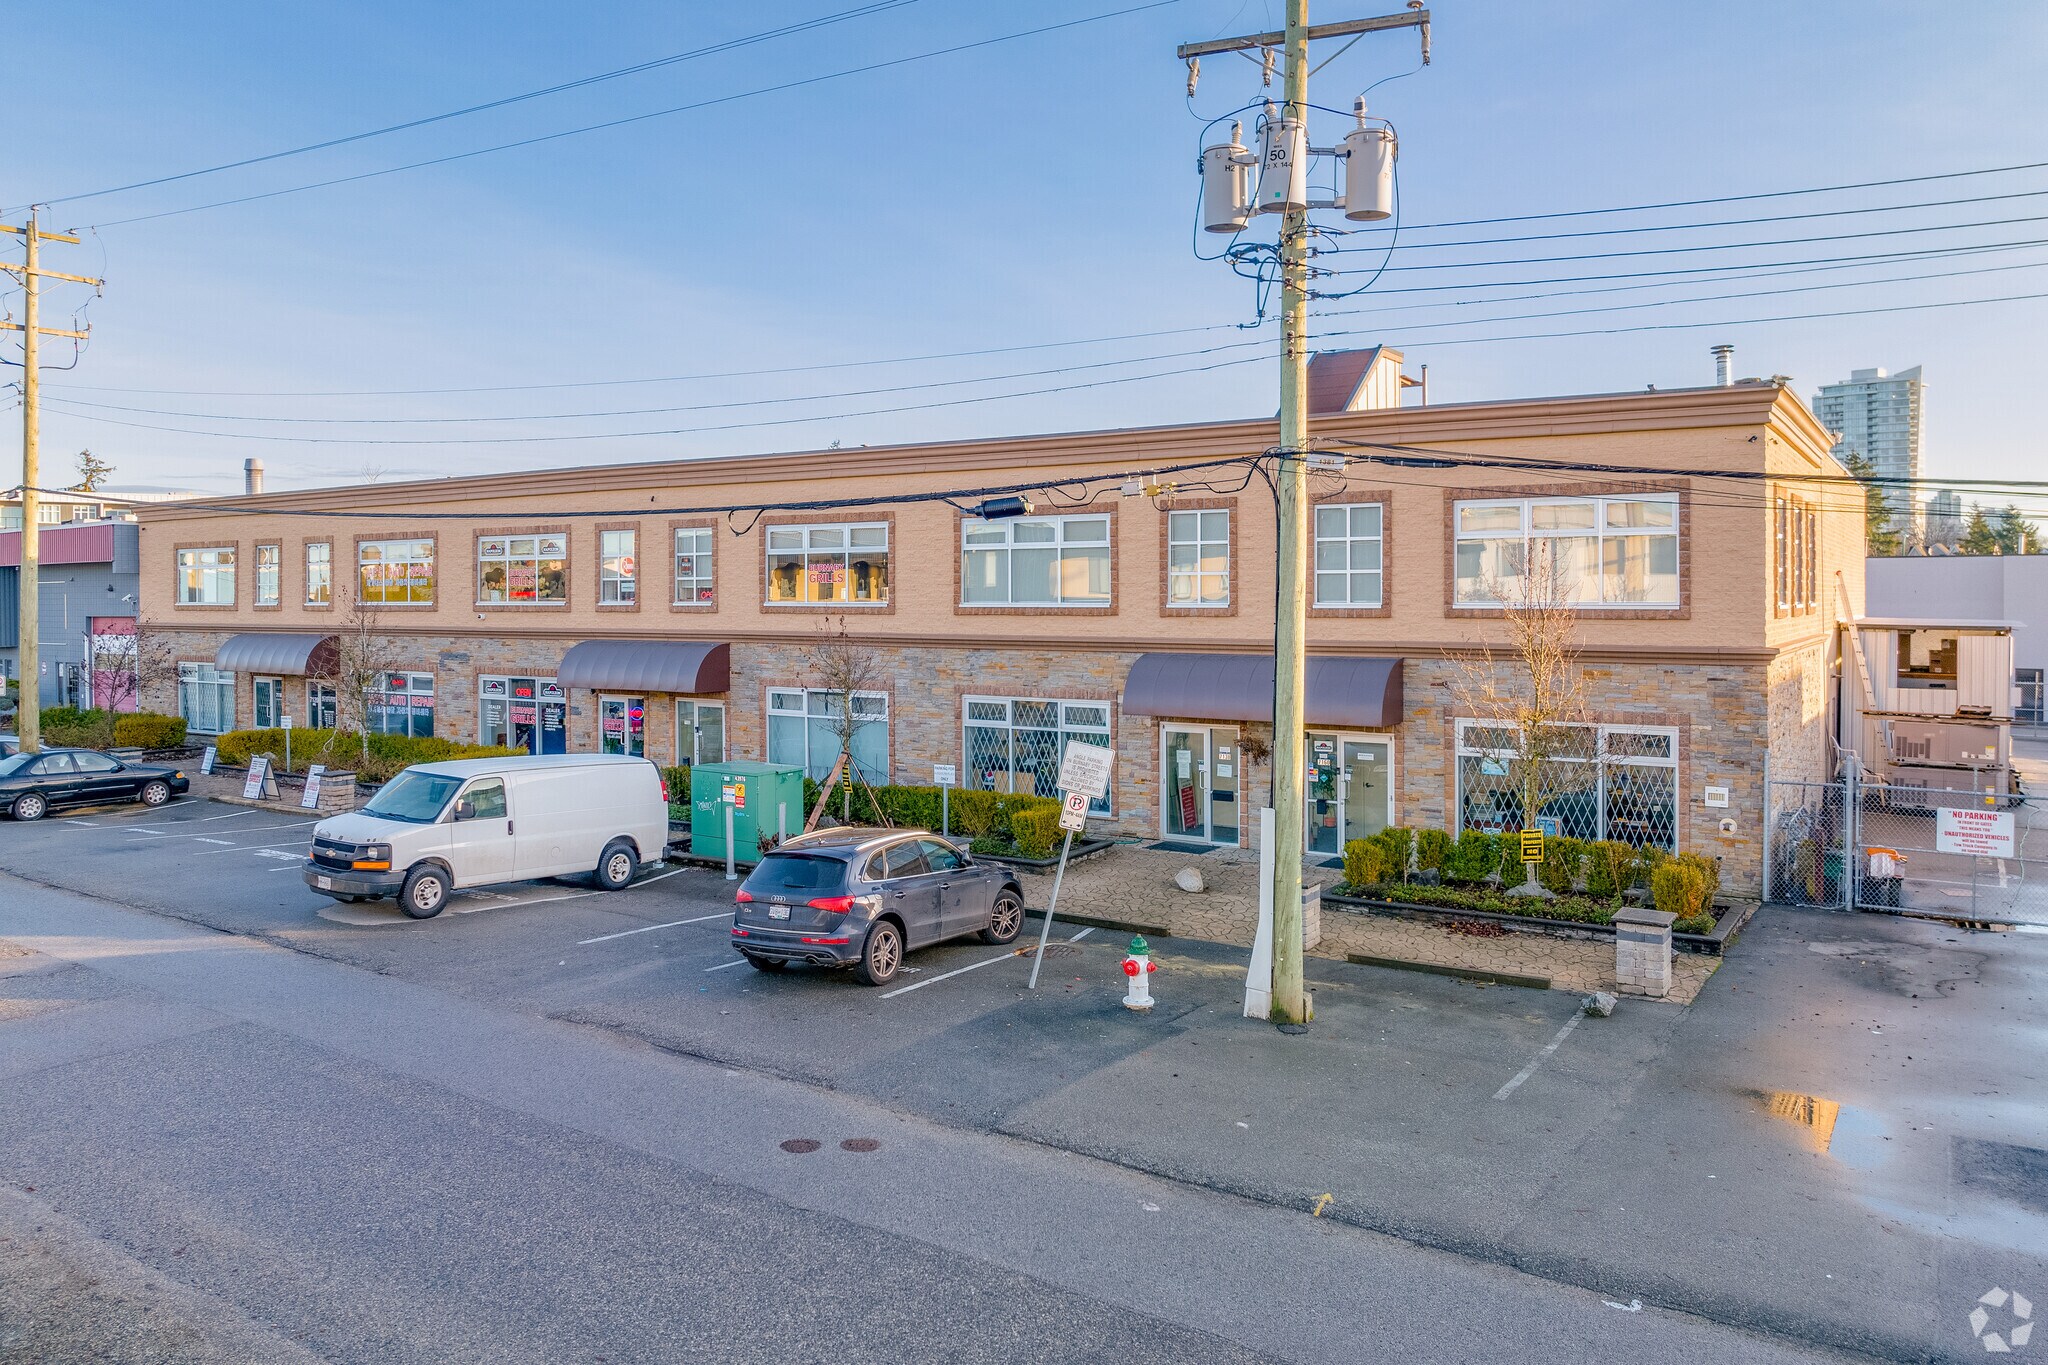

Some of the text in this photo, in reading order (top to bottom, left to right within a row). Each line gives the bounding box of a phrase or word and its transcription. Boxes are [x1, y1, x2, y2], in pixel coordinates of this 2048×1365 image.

[1270, 149, 1286, 161] 50
[808, 563, 845, 571] BURNABY
[510, 577, 536, 586] GRILLS
[809, 573, 844, 583] GRILLS
[516, 688, 532, 697] OPEN
[390, 695, 406, 706] AUTO
[411, 696, 434, 707] REPAIR
[510, 714, 536, 724] GRILLS
[1965, 812, 1998, 821] PARKING
[1944, 831, 1983, 839] UNAUTHORIZED
